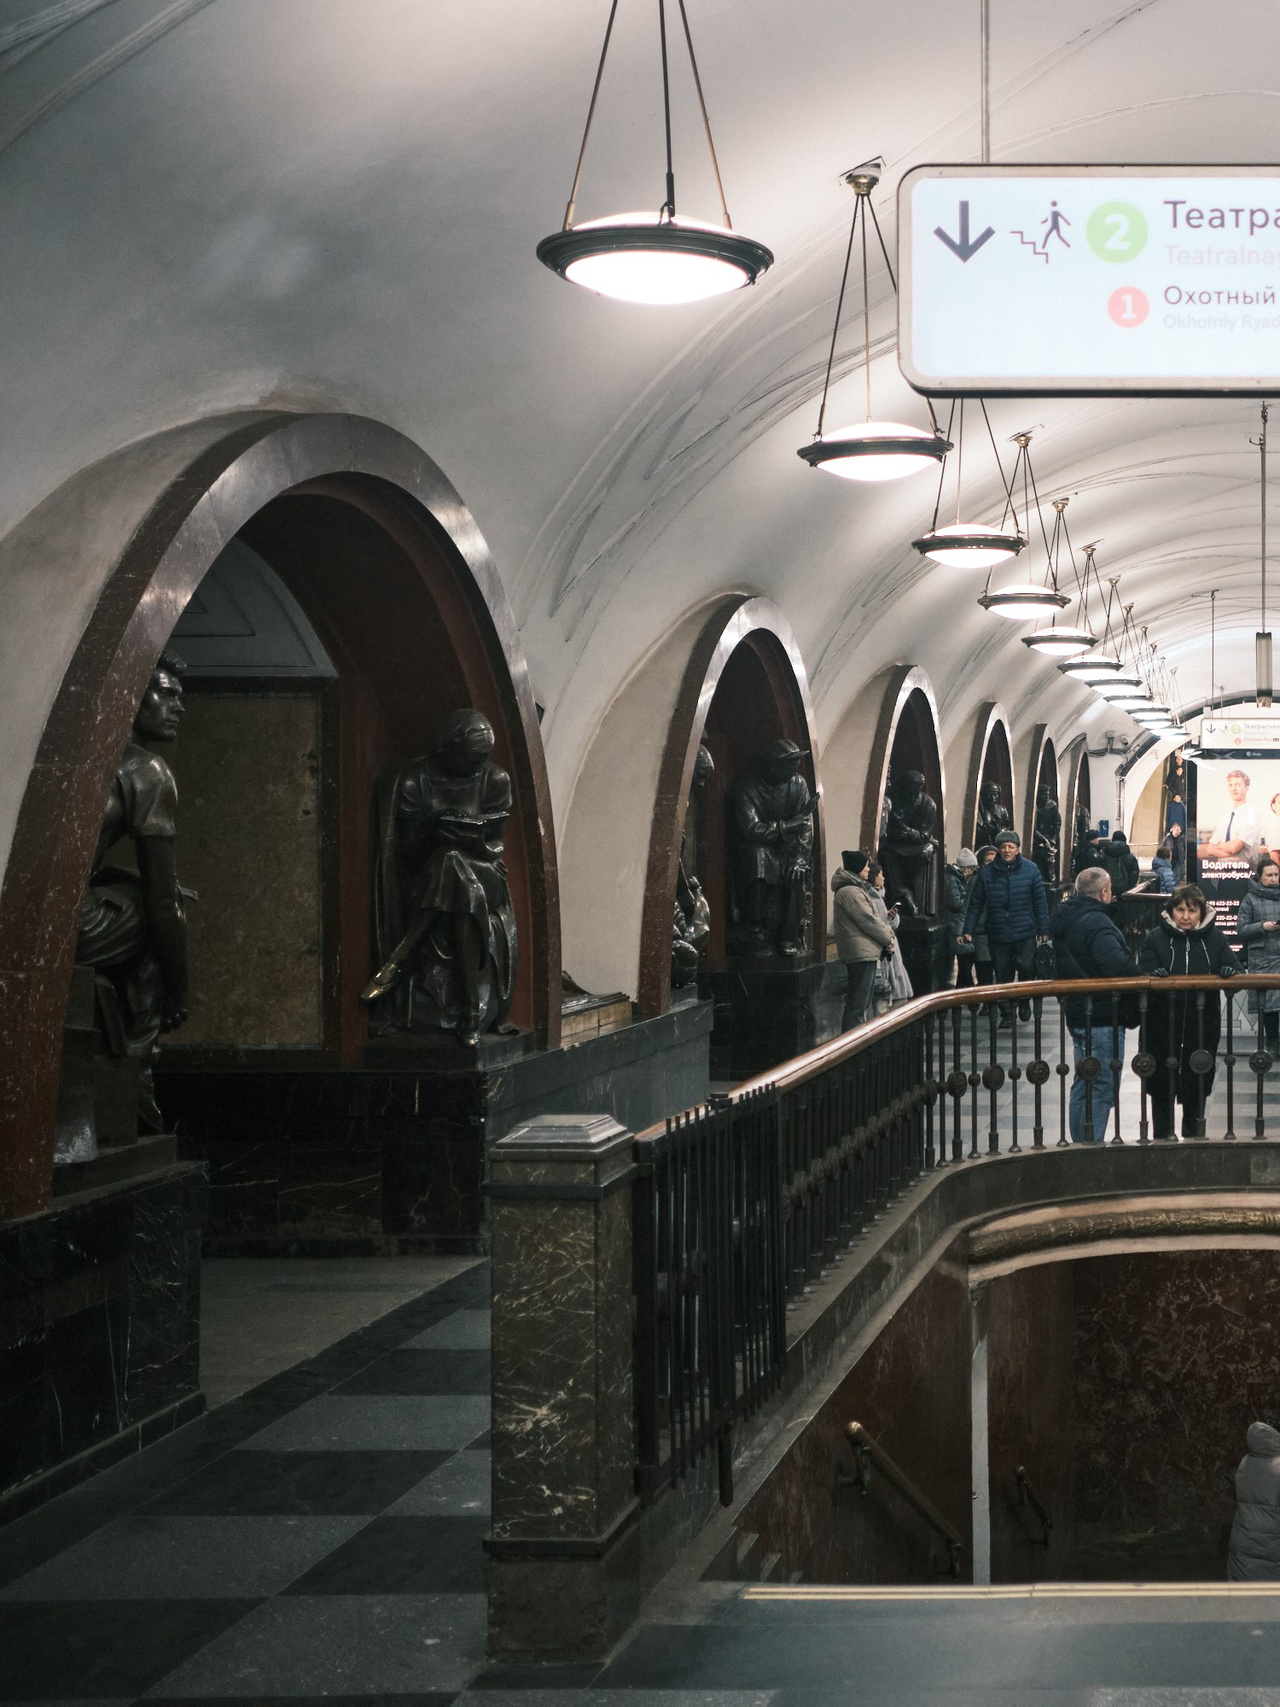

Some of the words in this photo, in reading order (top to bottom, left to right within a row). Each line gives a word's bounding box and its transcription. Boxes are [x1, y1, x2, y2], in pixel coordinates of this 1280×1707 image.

[1104, 213, 1131, 250] 2
[1121, 294, 1138, 319] 1
[1164, 285, 1276, 305] Охотный
[1163, 313, 1237, 331] Okhotniy
[1201, 860, 1250, 870] Водитель
